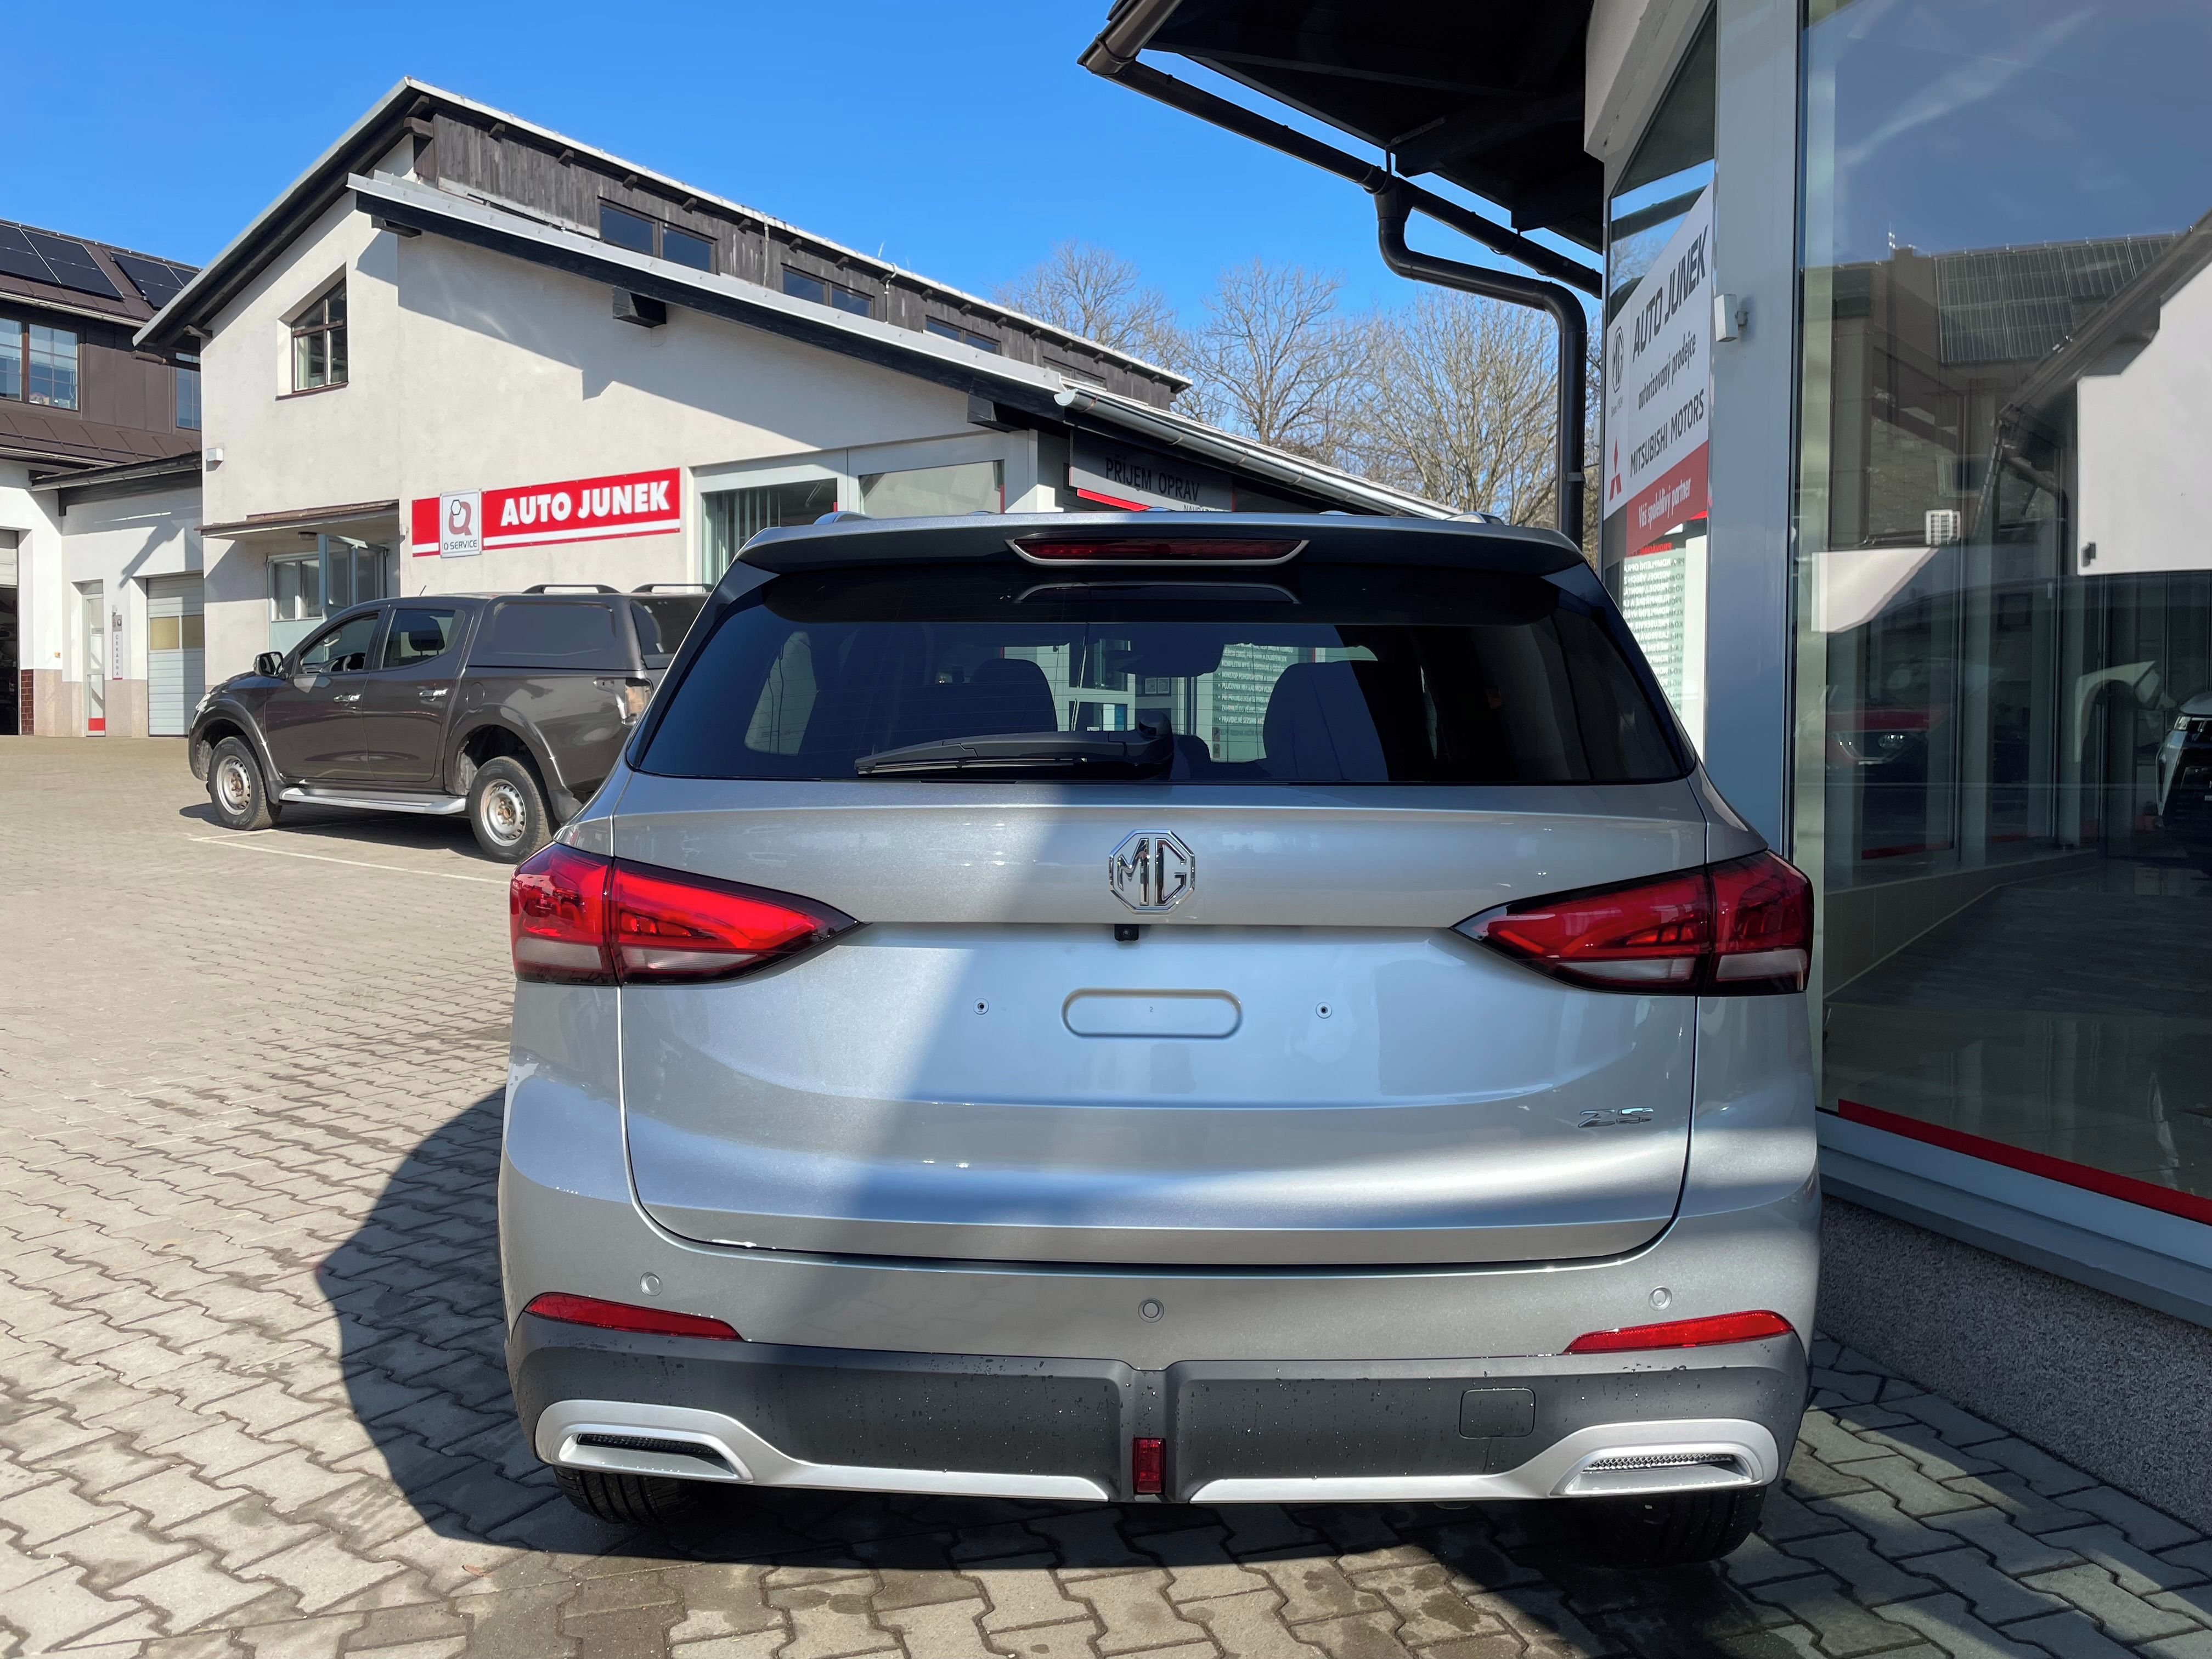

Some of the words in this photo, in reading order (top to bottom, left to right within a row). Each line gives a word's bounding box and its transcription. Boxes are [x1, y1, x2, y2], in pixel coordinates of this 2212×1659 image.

[1632, 286, 1663, 363] AUTO
[1664, 224, 1708, 325] JUNEK
[1638, 352, 1671, 410] autorizovaný
[1672, 330, 1696, 386] prodejce
[1630, 422, 1668, 478] MITSUBISHI
[1671, 388, 1704, 444] MOTORS
[1106, 454, 1152, 490] PŘÍJEM
[1159, 472, 1199, 501] OPRAV
[1671, 477, 1691, 516] partner
[500, 492, 571, 527] AUTO
[578, 481, 670, 519] JUNEK
[443, 542, 449, 550] Q
[450, 538, 478, 550] SERVICE
[1117, 837, 1187, 906] MG
[1578, 1107, 1654, 1128] ZS
